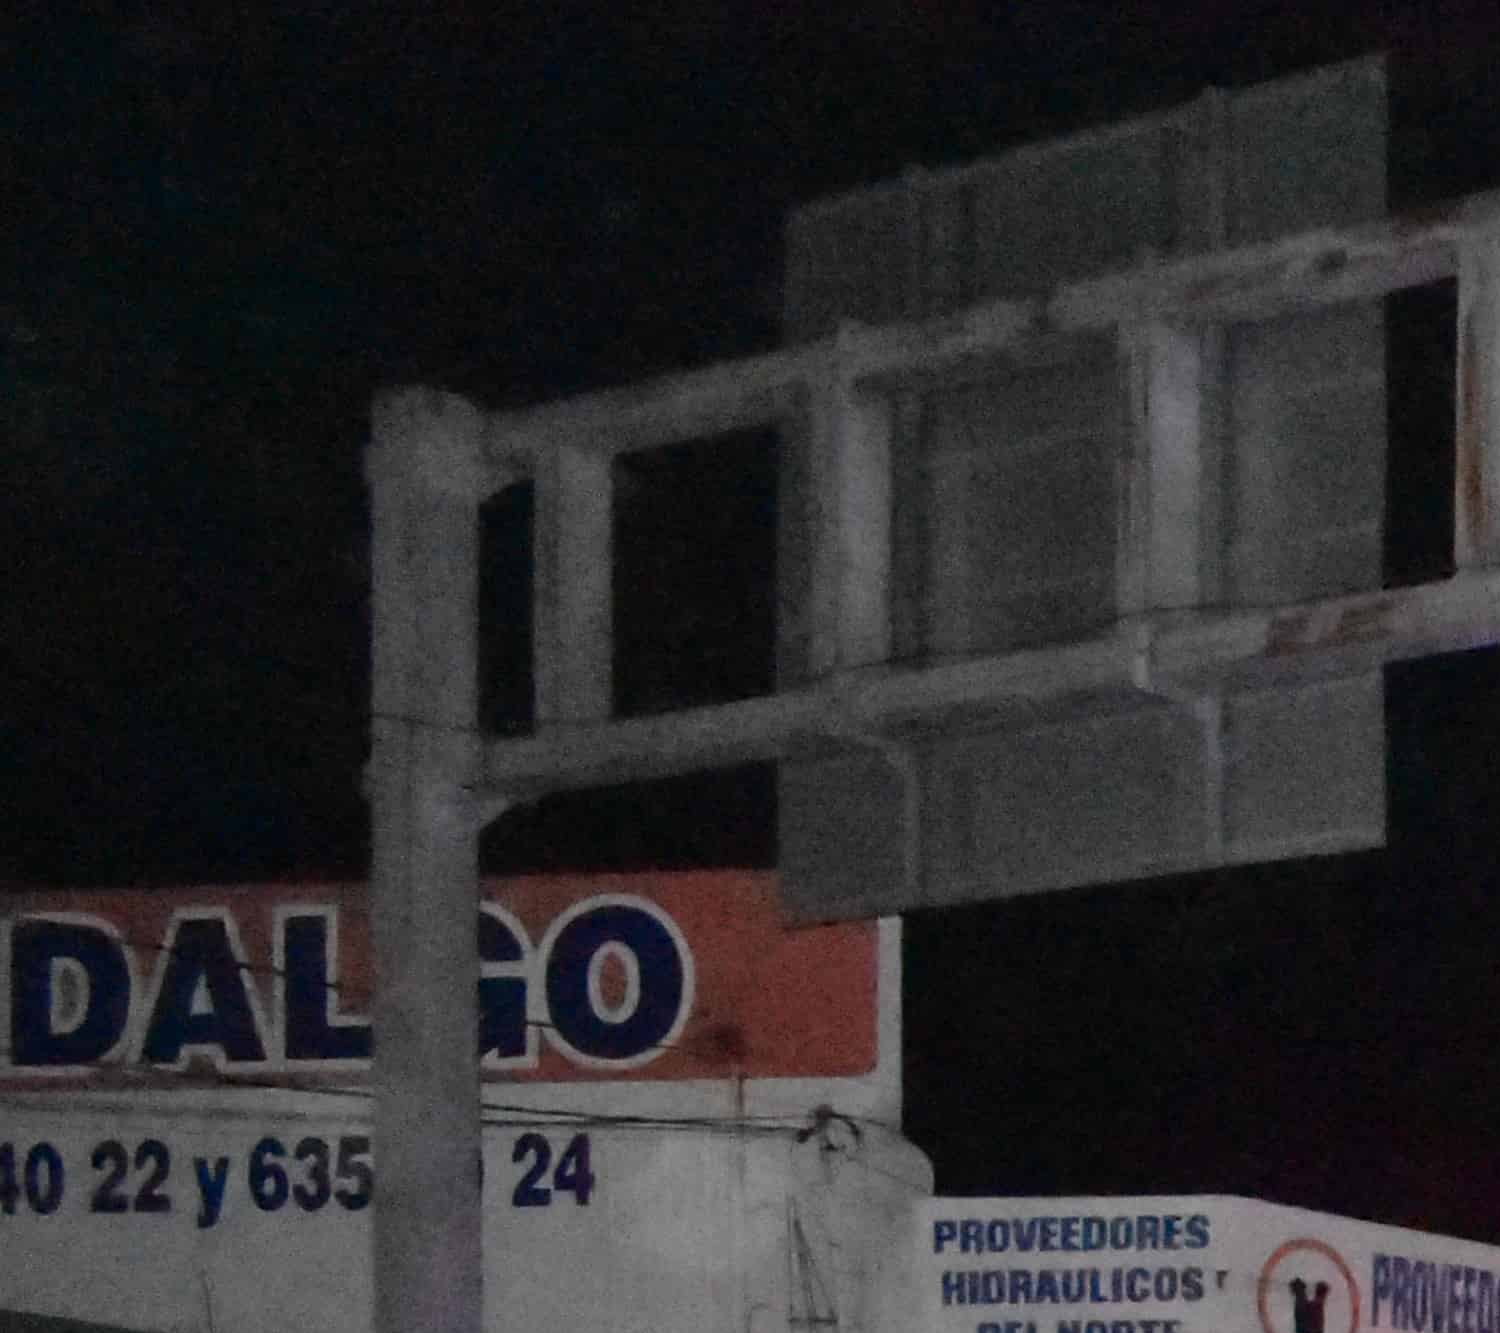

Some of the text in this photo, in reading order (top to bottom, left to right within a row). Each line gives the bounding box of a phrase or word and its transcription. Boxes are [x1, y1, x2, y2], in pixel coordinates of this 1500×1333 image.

[91, 1138, 171, 1214] 22
[193, 1153, 230, 1227] y
[248, 1135, 374, 1212] 635
[511, 1132, 595, 1207] 24
[932, 1214, 1211, 1254] PROVEEDORES
[941, 1268, 1204, 1307] HIDRAULICOS
